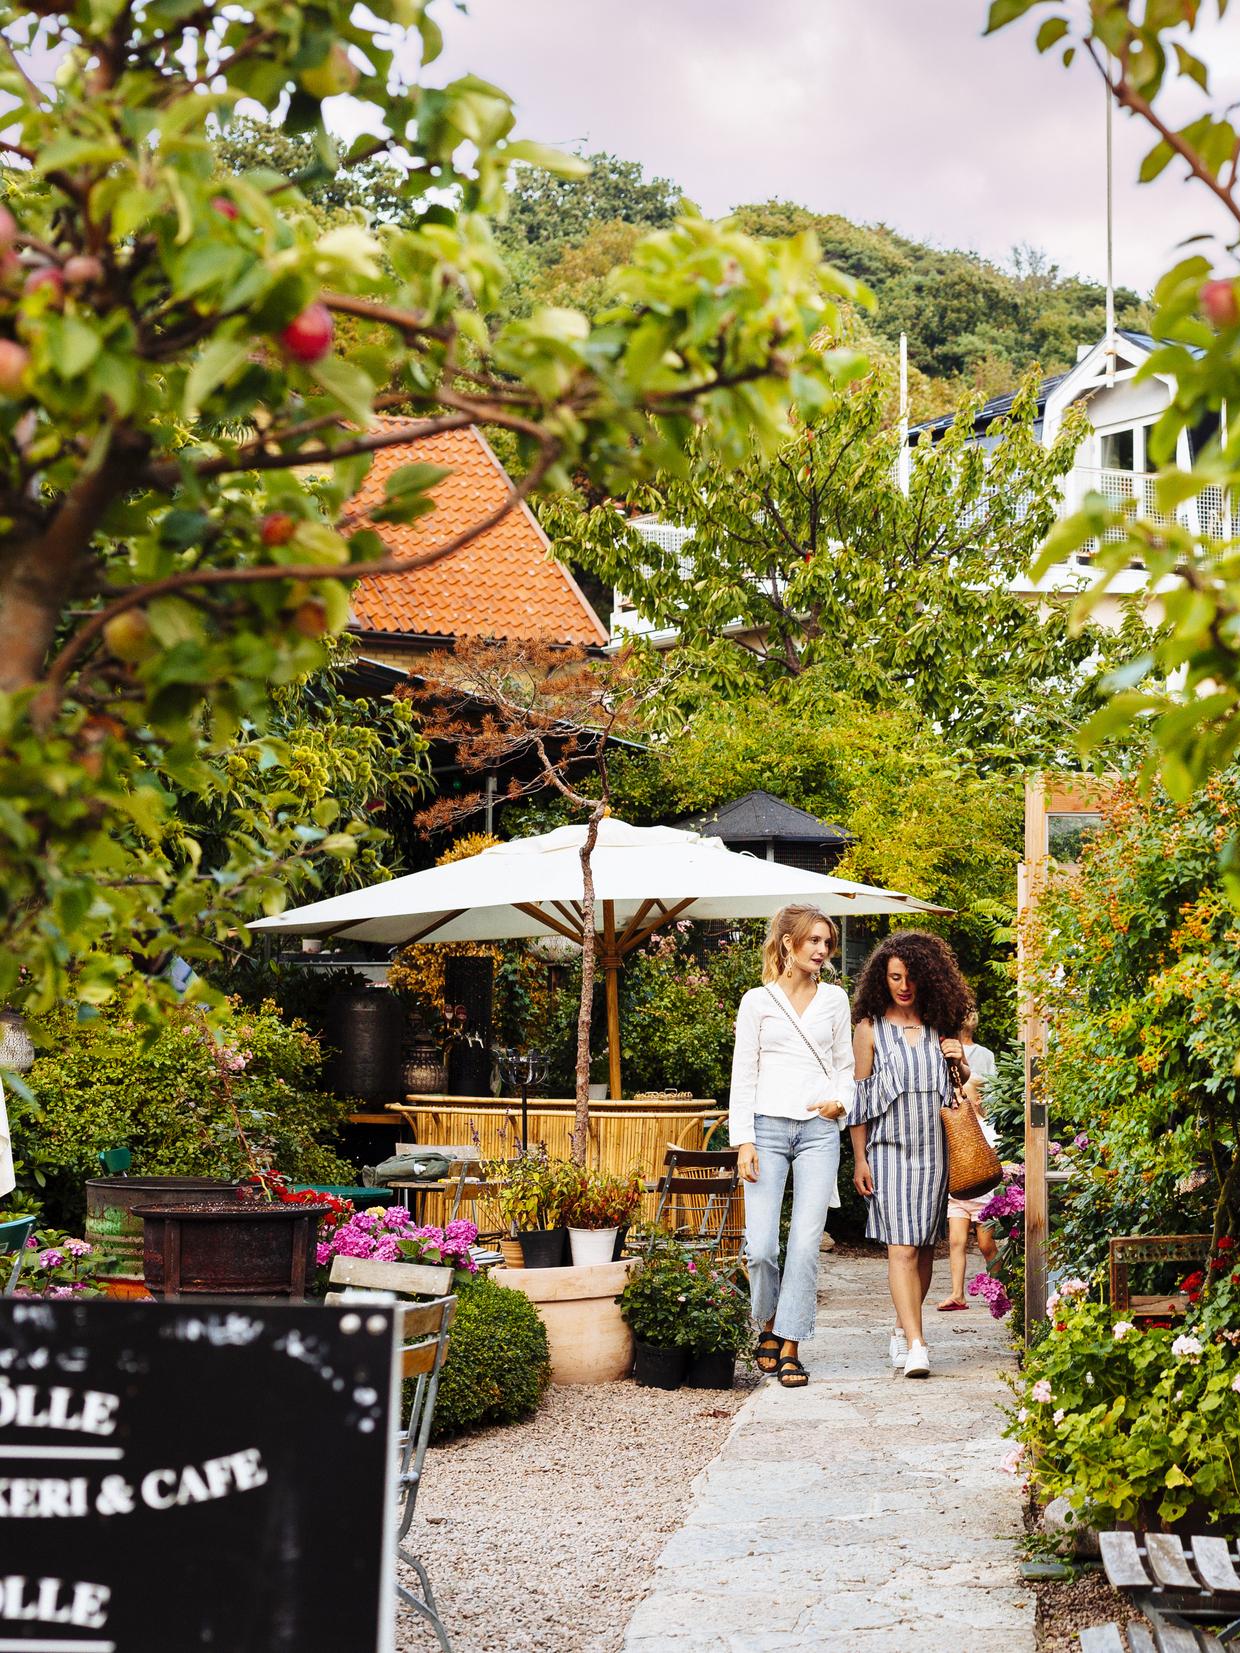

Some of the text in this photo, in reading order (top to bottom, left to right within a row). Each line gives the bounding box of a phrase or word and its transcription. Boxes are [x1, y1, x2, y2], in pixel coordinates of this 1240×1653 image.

[95, 1473, 136, 1516] &
[140, 1447, 269, 1510] CAFE
[0, 1574, 112, 1629] LLE
